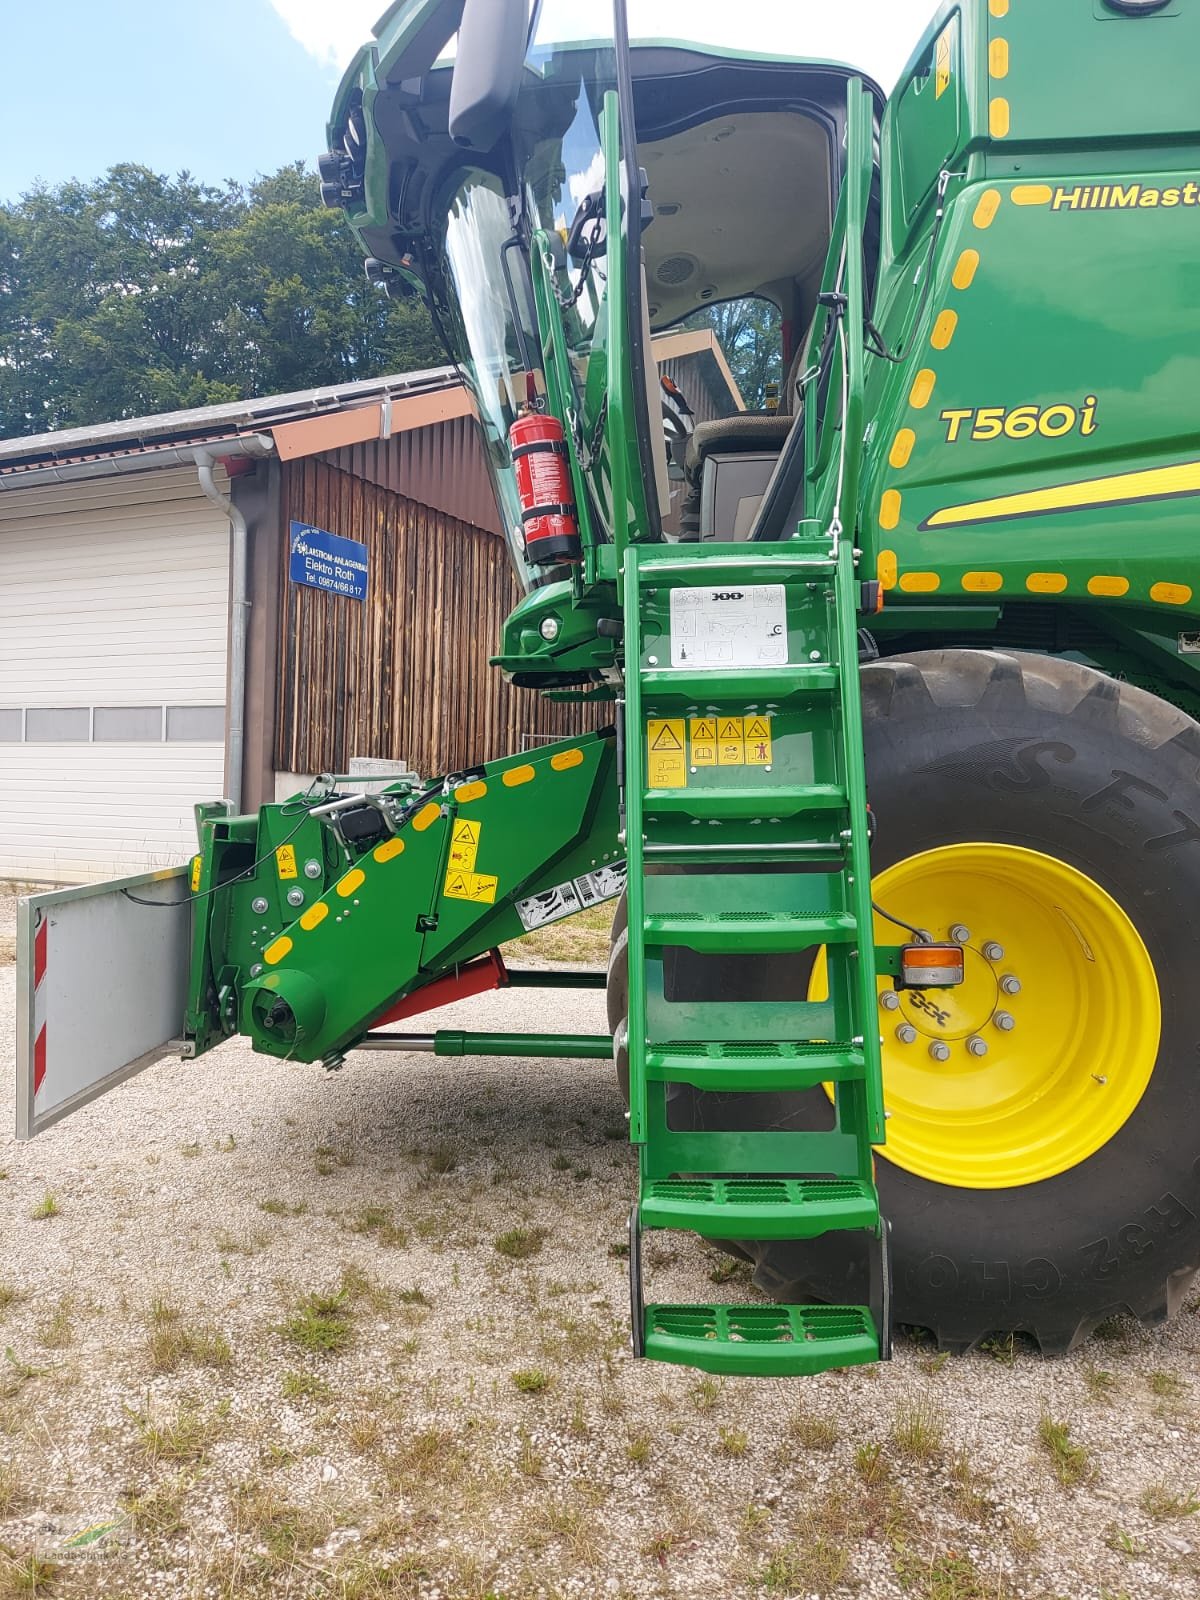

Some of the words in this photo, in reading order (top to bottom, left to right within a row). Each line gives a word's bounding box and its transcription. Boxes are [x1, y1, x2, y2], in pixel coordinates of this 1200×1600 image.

[1050, 181, 1200, 211] HillMast
[940, 394, 1099, 443] T560i
[305, 557, 333, 575] Elektro
[335, 566, 355, 582] Roth
